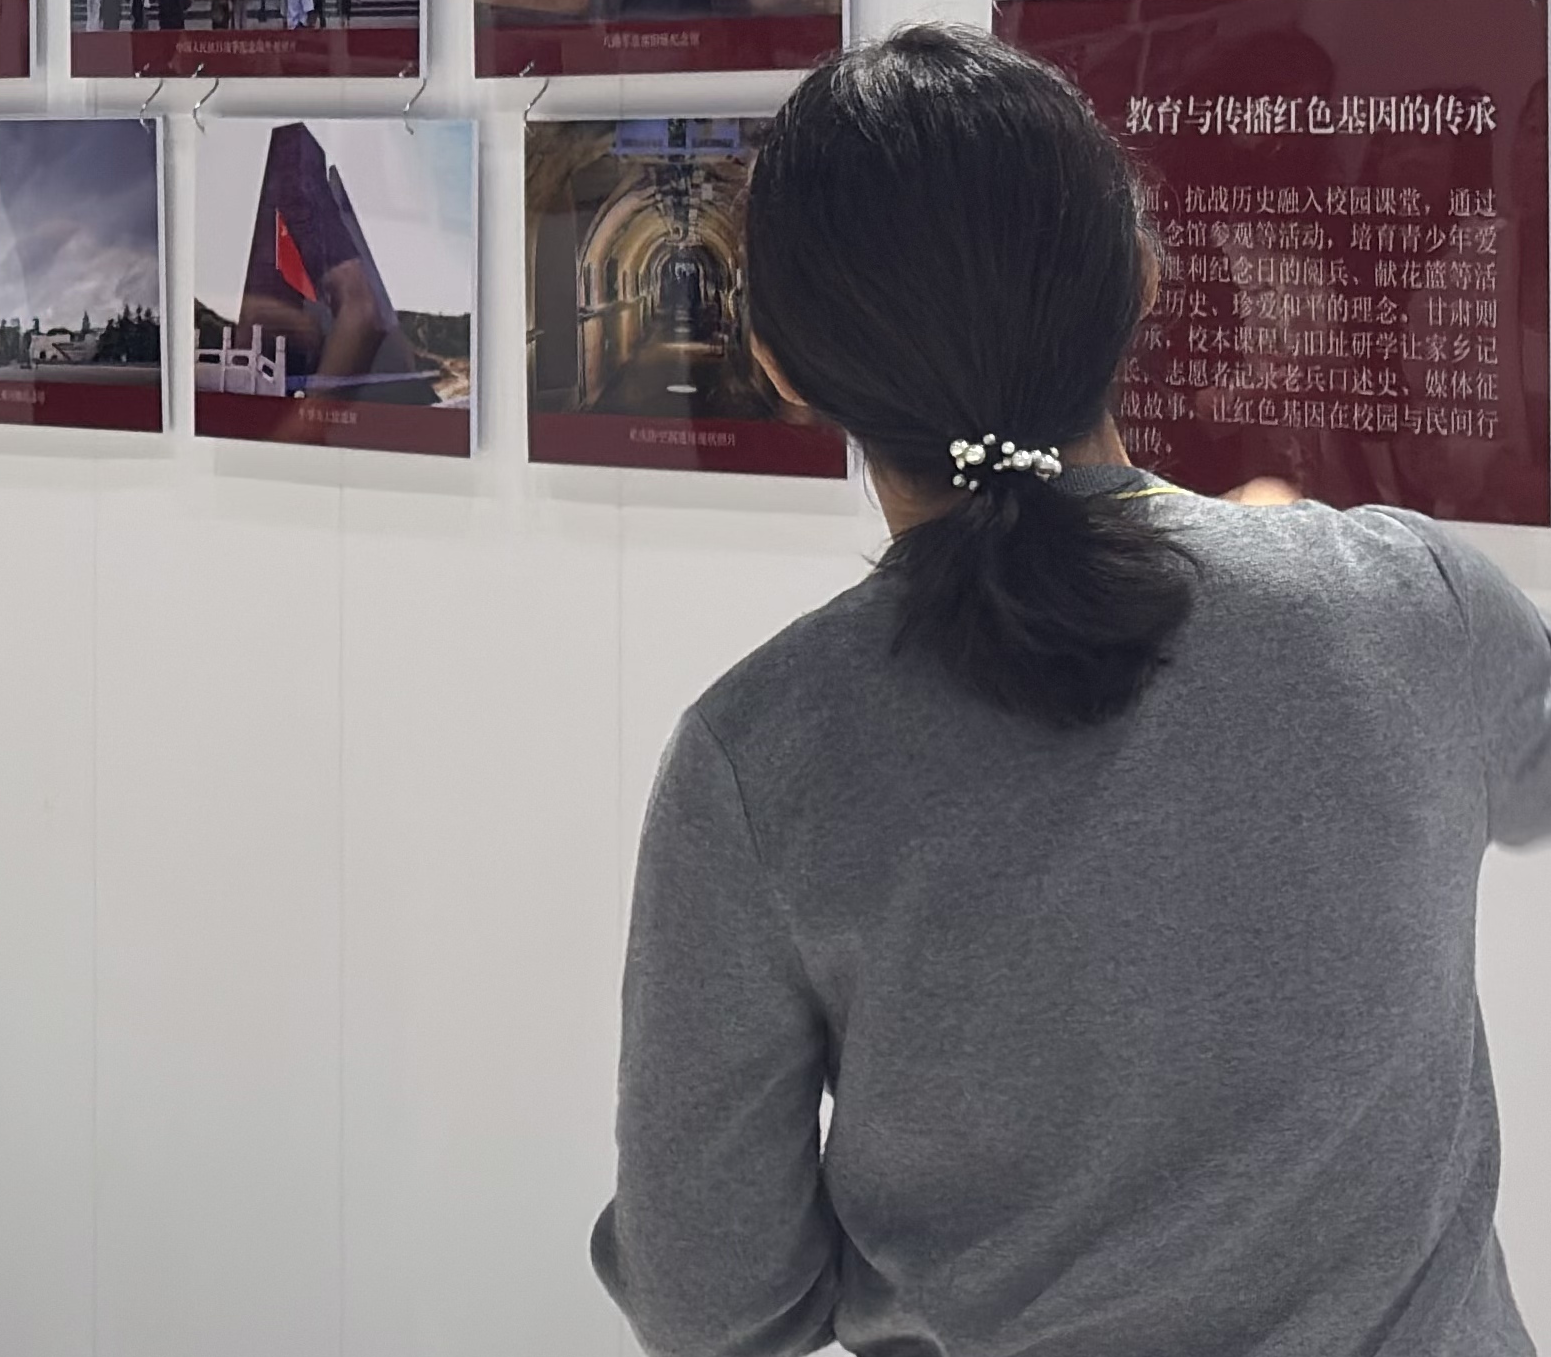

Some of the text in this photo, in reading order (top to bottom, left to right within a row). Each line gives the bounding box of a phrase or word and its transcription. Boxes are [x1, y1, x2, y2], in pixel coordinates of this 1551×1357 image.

[1126, 94, 1497, 135] 教育与传播红色基因的传承
[1157, 219, 1497, 255] 念馆参观等活动，培育青少年爱
